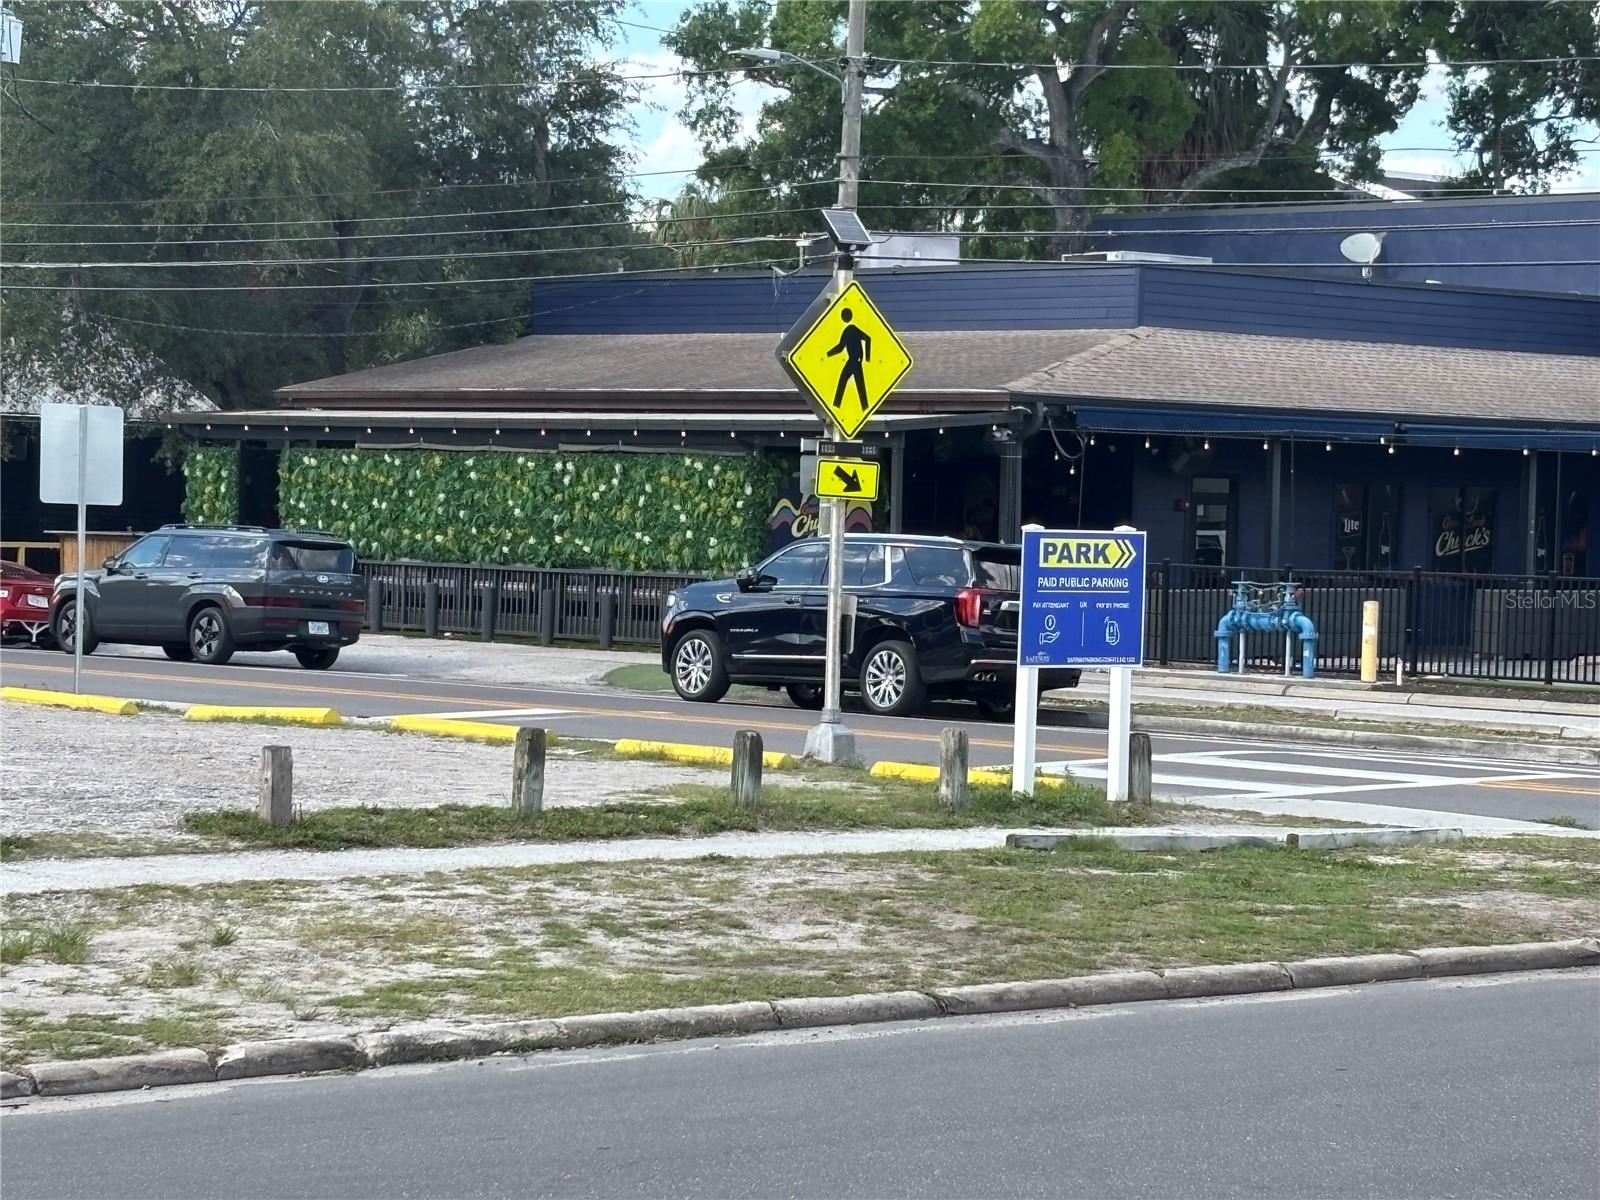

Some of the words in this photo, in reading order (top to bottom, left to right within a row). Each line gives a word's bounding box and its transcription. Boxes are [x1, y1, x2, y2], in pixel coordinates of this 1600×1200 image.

[1043, 542, 1112, 565] PARK
[1038, 577, 1057, 587] PAID
[1060, 577, 1090, 588] PUBLIC
[1091, 578, 1129, 588] PARKING
